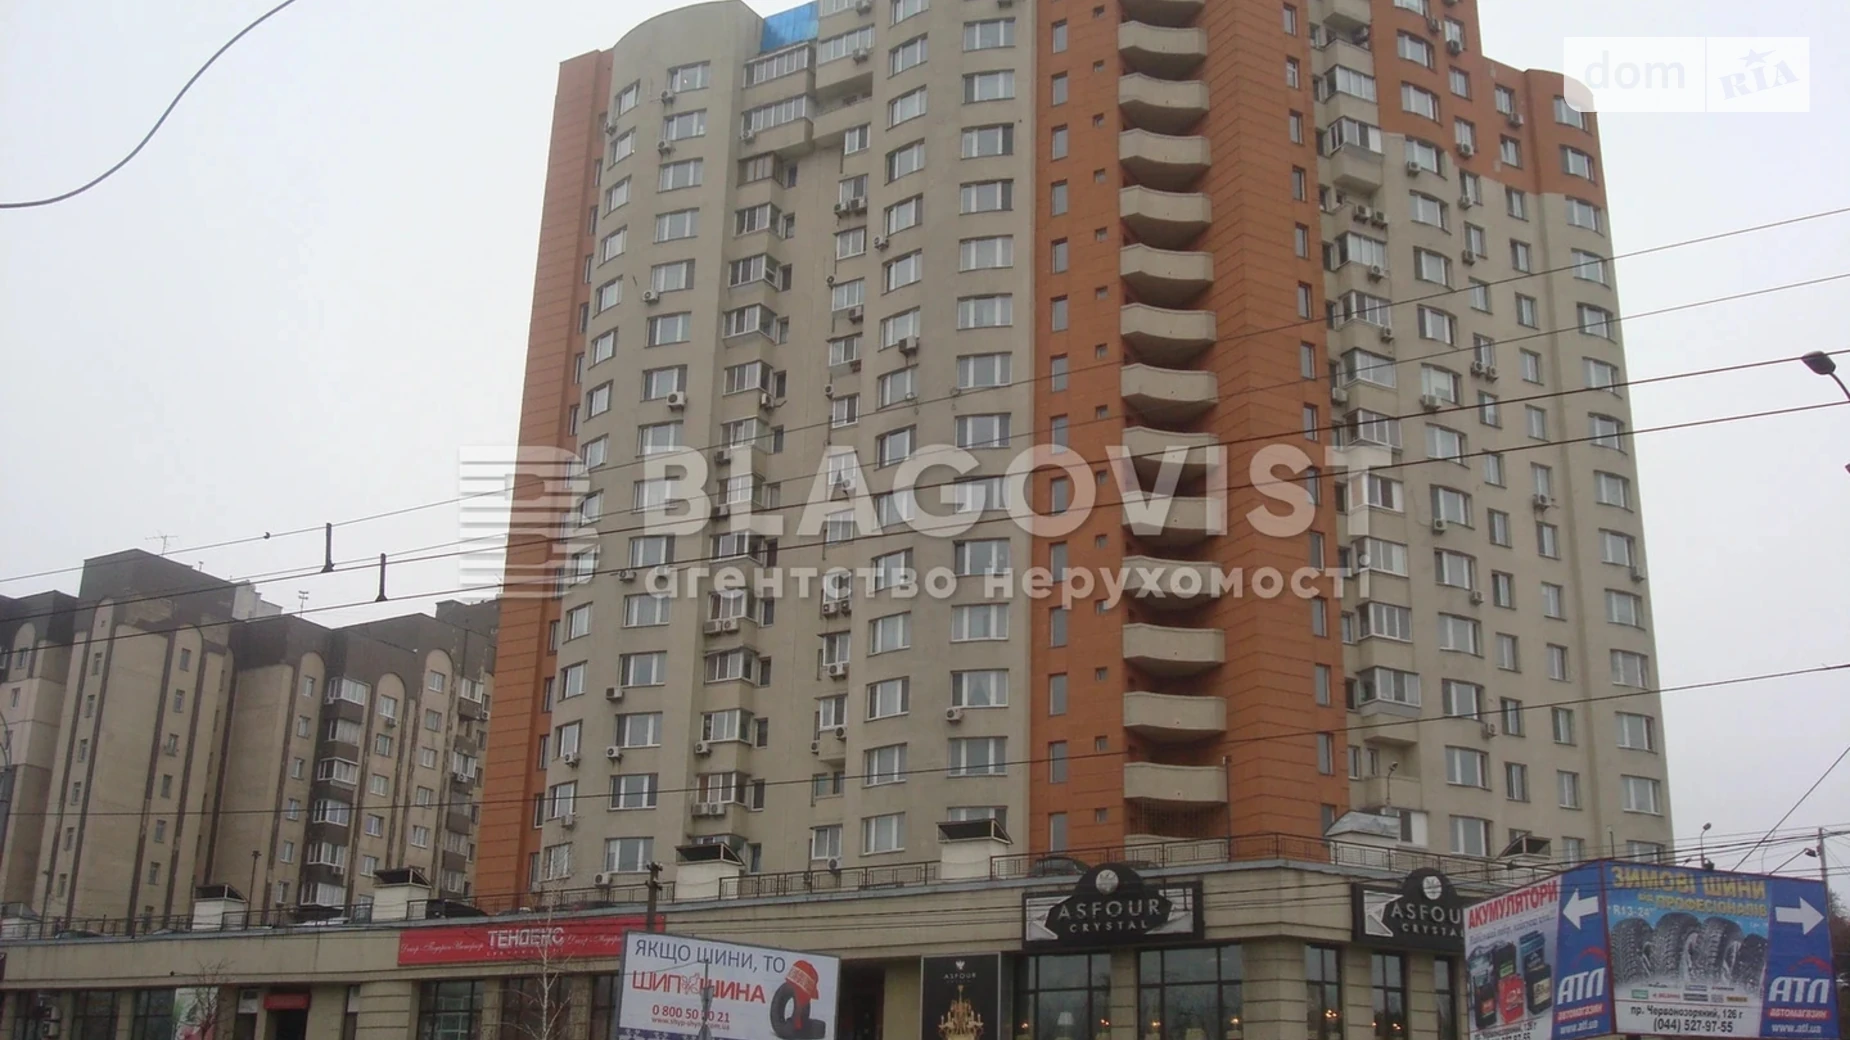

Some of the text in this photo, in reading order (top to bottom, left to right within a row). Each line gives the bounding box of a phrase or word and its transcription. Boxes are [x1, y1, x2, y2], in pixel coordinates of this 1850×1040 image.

[1611, 866, 1766, 899] ЗИМОВІ ШИНИ
[1057, 898, 1161, 921] ASFOUR
[1391, 901, 1461, 924] ASFOU
[1469, 879, 1558, 929] АКУМУЛЯТОРИ
[1655, 894, 1769, 918] ПРОФЕСІОНАЛІВ
[1069, 920, 1149, 934] CRYSTAL
[635, 939, 786, 973] ЯКЩО ШИНИ, ТО
[652, 1004, 730, 1023] 0 800 50 0 21
[1630, 1005, 1645, 1016] пр.
[1722, 1008, 1737, 1019] 126
[1653, 1018, 1734, 1033] (044) 527-97-55
